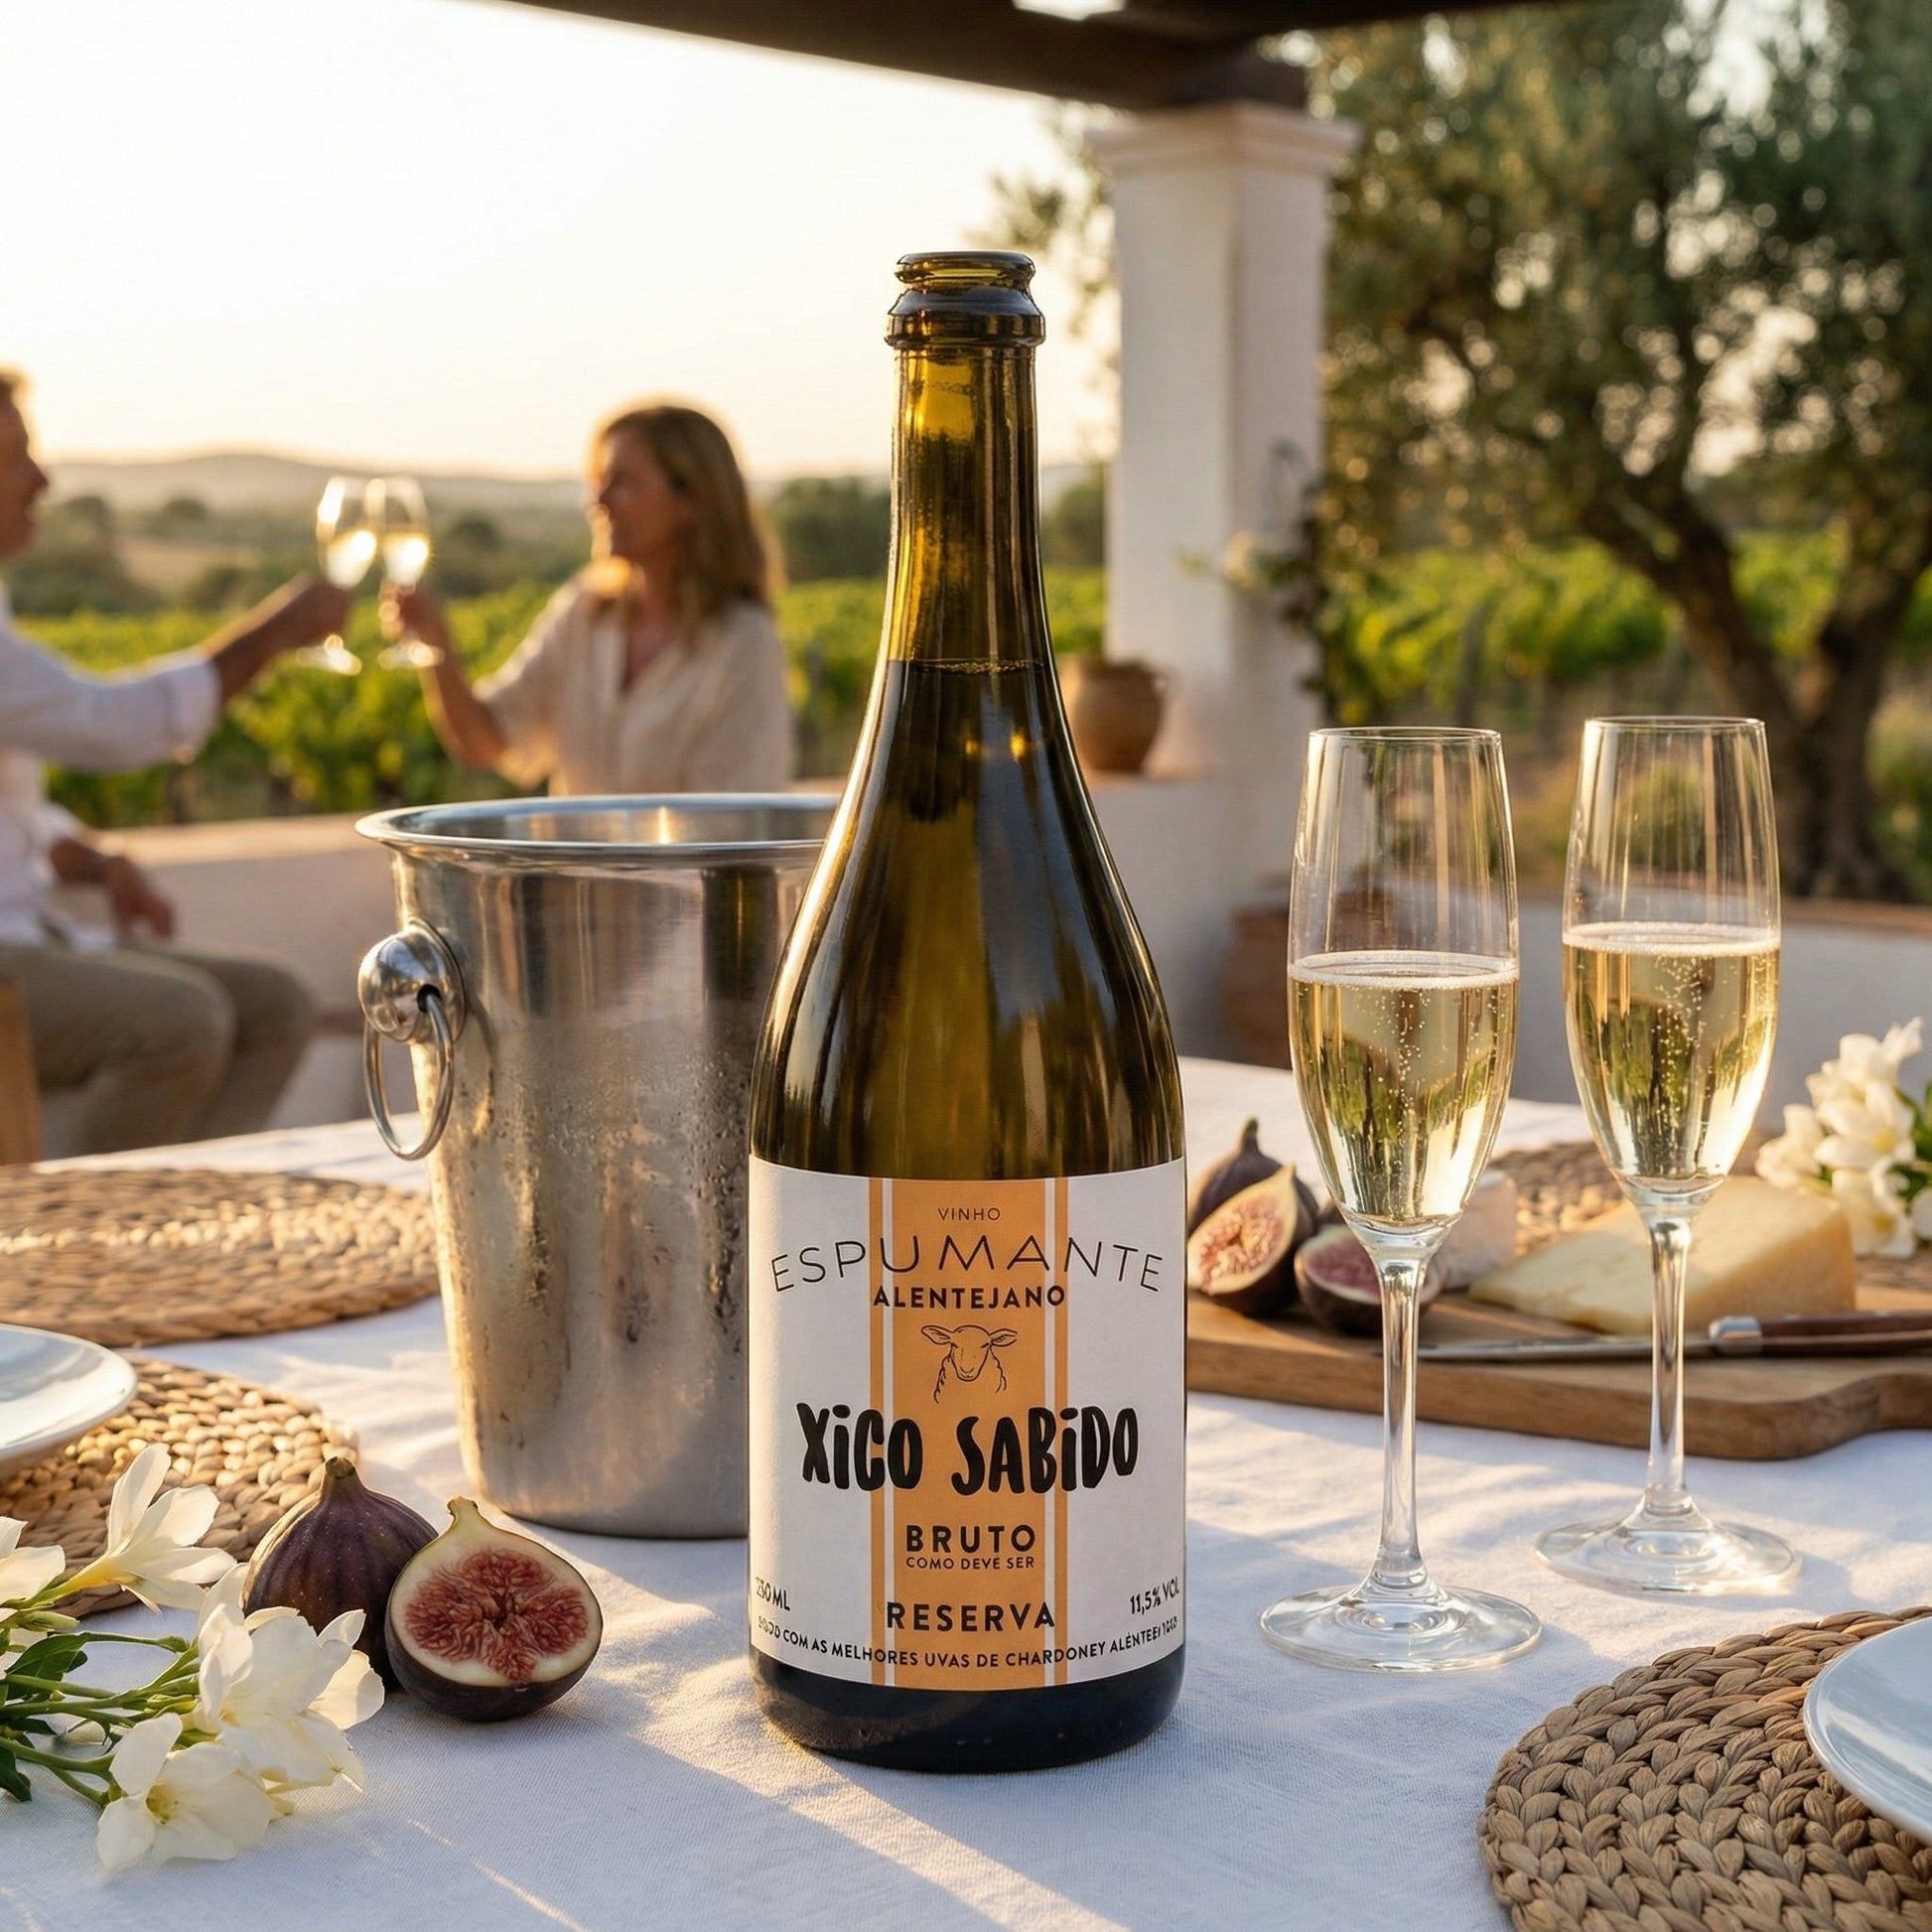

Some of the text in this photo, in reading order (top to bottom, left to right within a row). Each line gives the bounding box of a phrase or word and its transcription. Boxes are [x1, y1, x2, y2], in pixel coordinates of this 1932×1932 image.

[937, 1207, 1001, 1221] VINHO
[770, 1234, 1164, 1293] ESPUMANTE
[873, 1285, 1065, 1309] ALENTEJANO
[905, 1524, 1035, 1553] BRUTO
[905, 1556, 1035, 1570] COMO DEVE SER
[1130, 1586, 1161, 1614] 11,5%
[887, 1601, 1055, 1631] RESERVA
[783, 1629, 808, 1649] COM
[811, 1637, 828, 1654] AS
[832, 1641, 917, 1667] MELHORES
[924, 1652, 970, 1668] UVAS
[976, 1653, 999, 1668] DE
[1005, 1641, 1106, 1668] CHARDONEY
